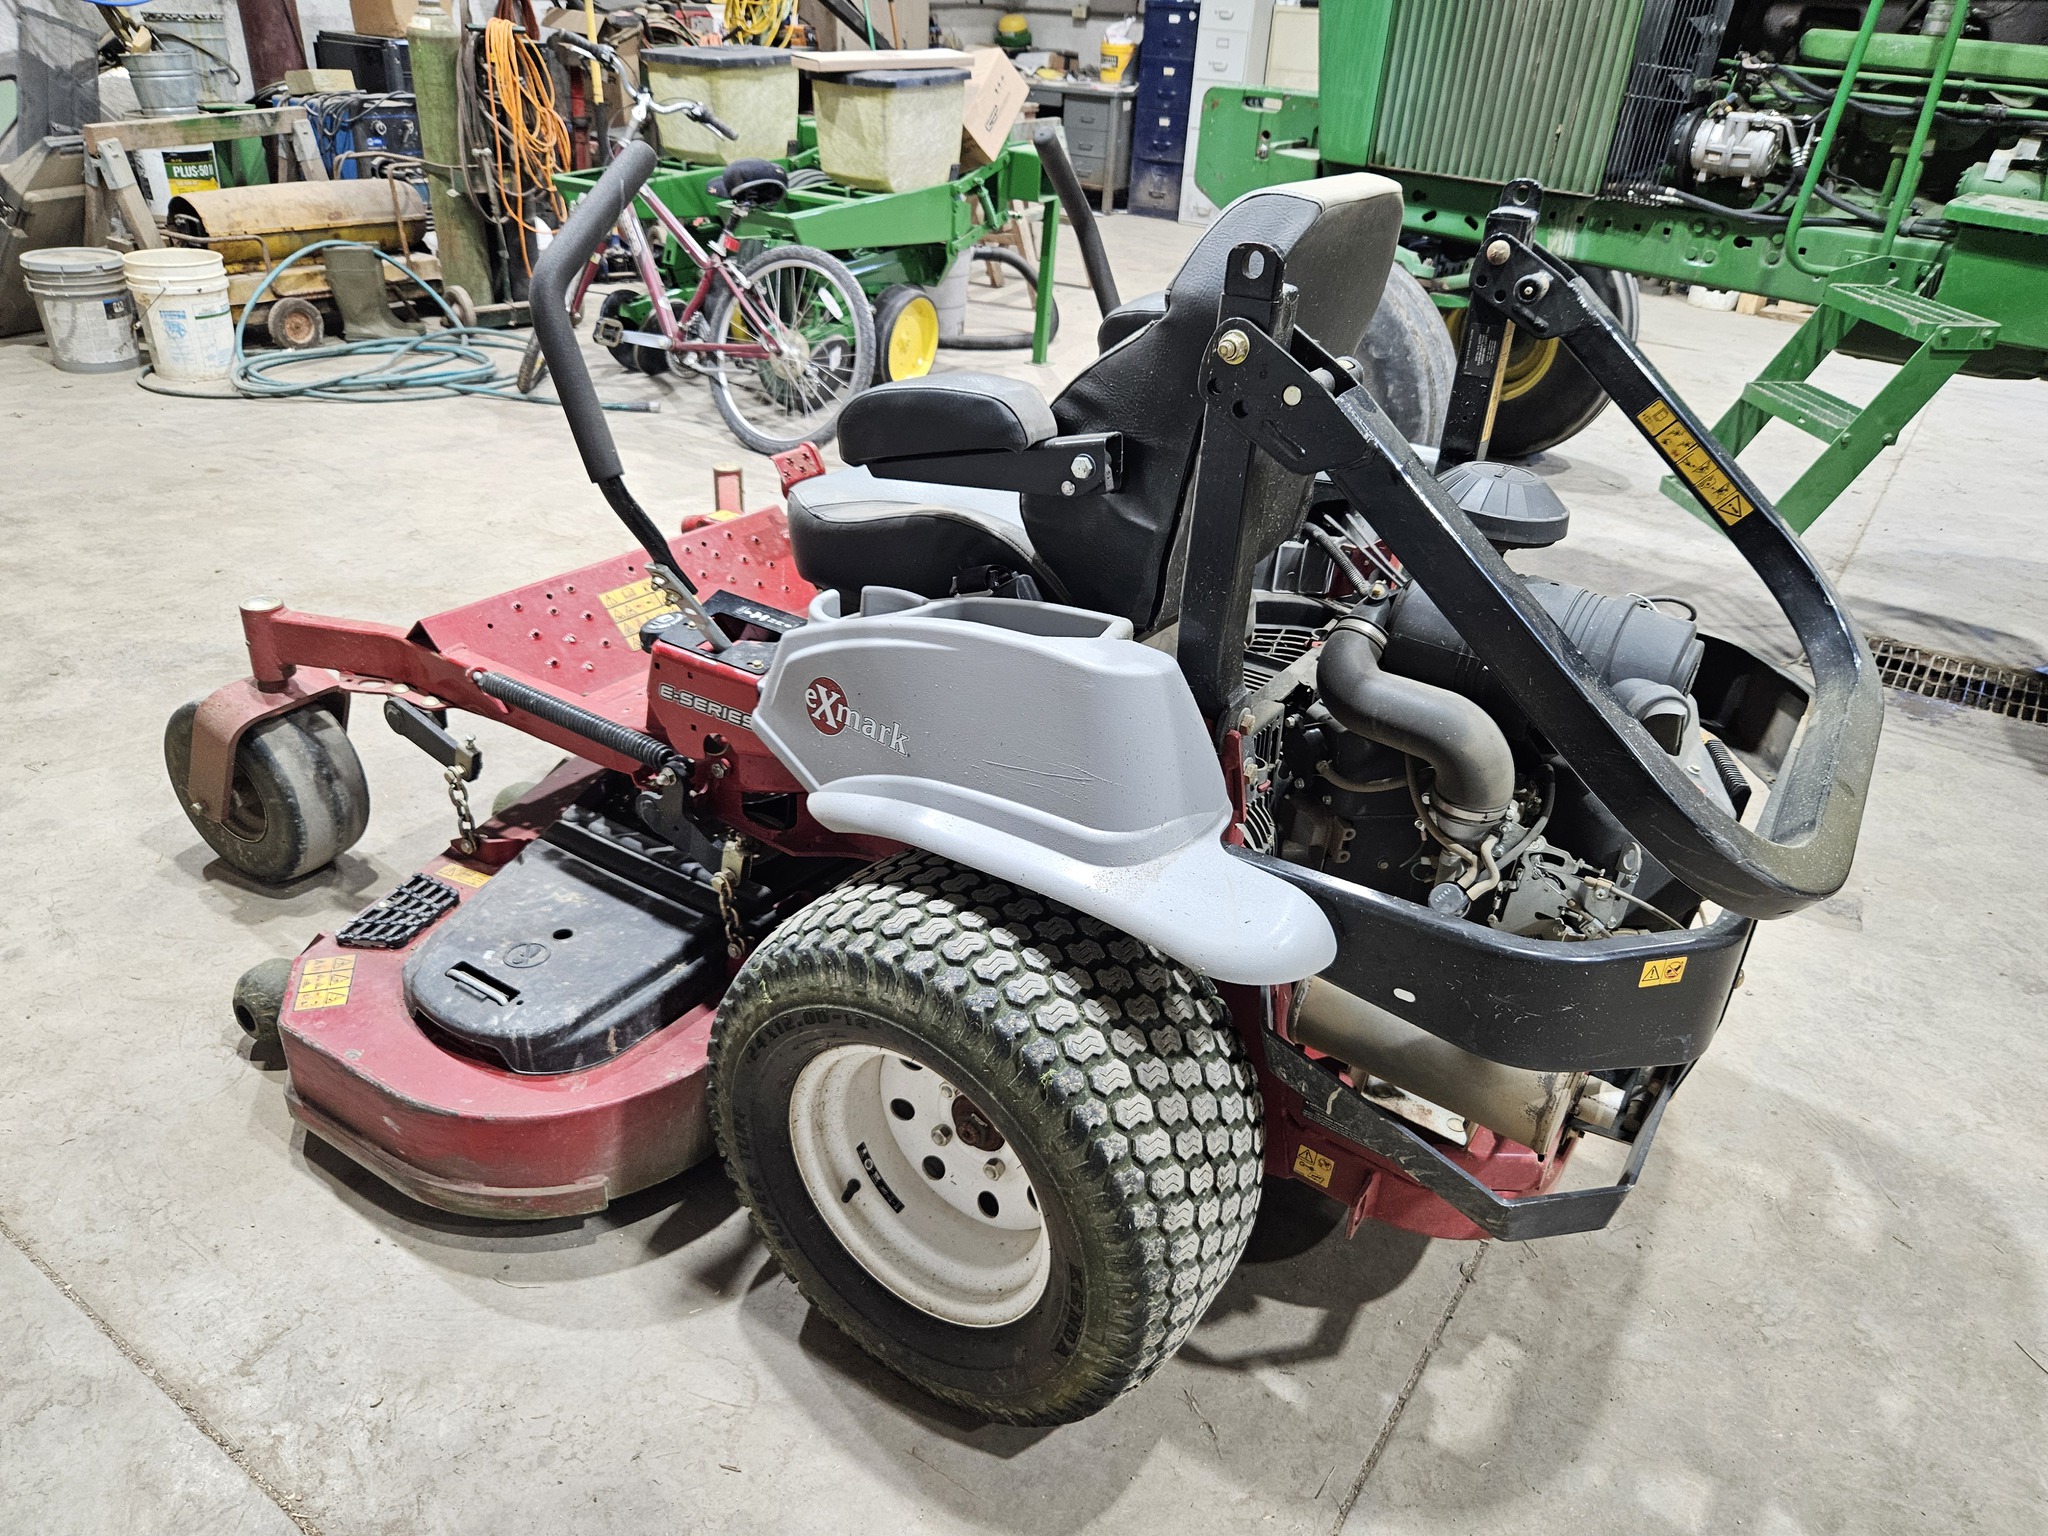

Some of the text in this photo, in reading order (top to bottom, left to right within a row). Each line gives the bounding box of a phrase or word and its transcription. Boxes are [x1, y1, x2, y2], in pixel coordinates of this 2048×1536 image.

[172, 165, 208, 177] PLUS-50
[658, 682, 754, 731] E-SERIES
[805, 683, 910, 756] eXmark
[1055, 1262, 1086, 1358] KENDA
